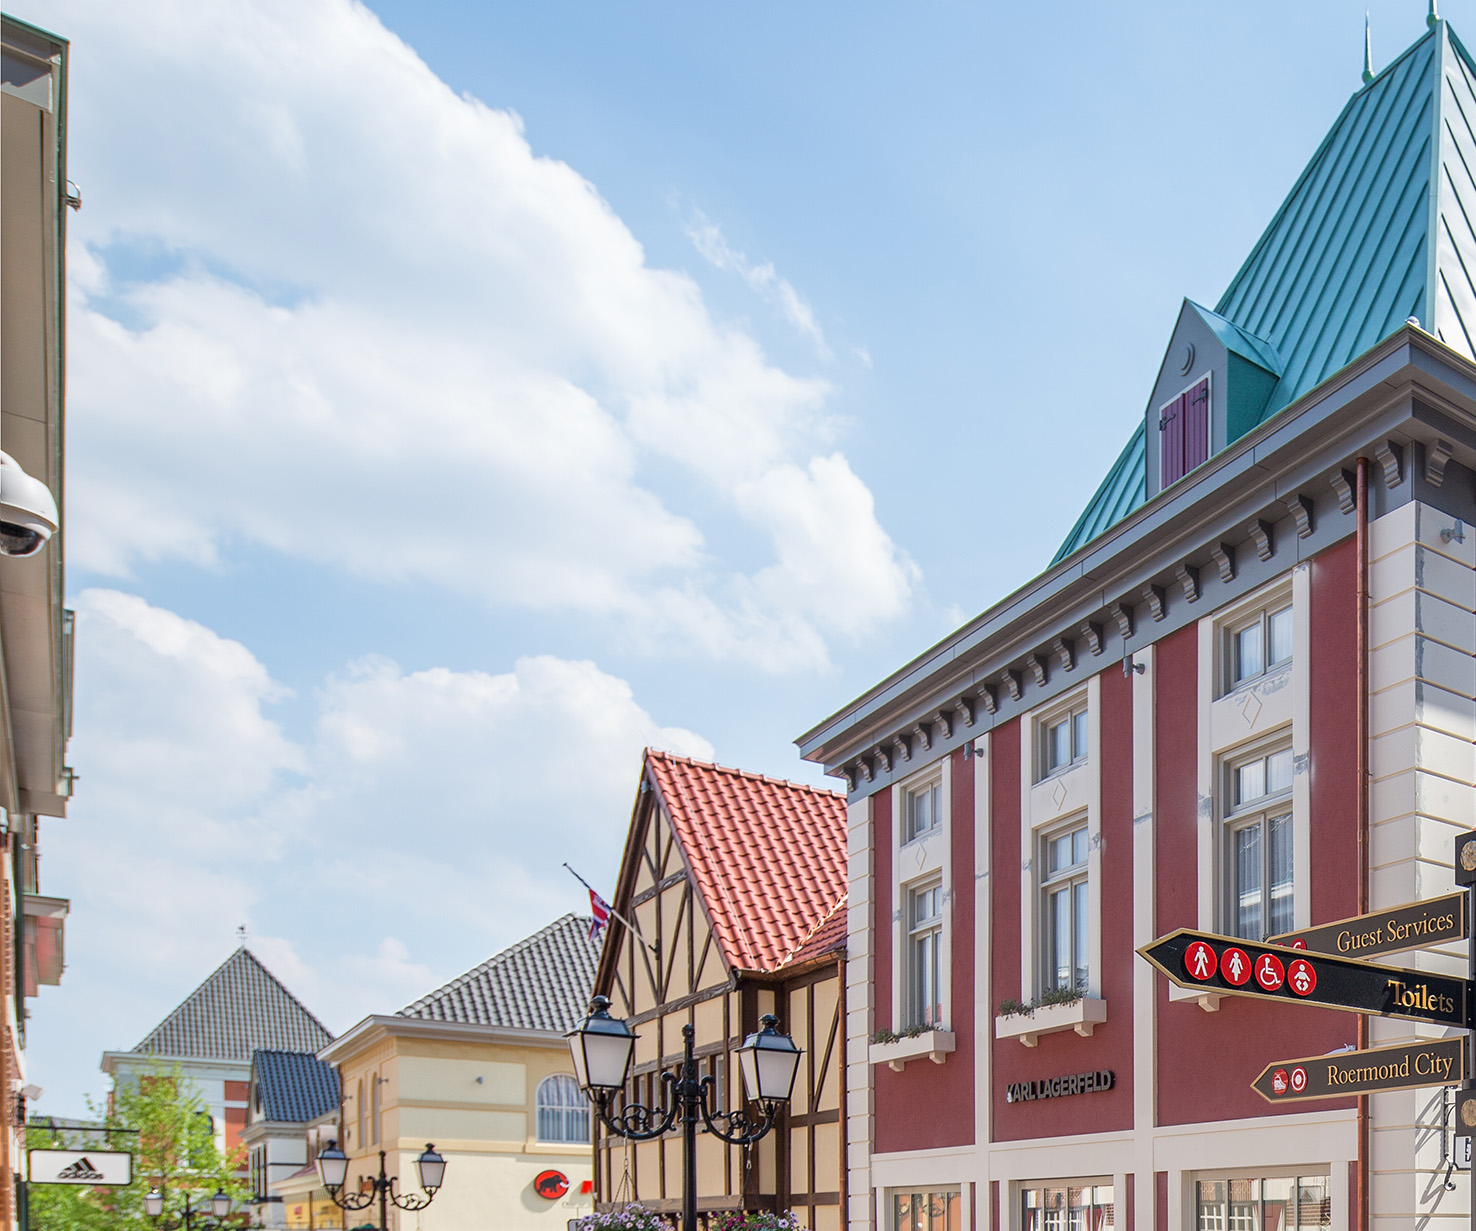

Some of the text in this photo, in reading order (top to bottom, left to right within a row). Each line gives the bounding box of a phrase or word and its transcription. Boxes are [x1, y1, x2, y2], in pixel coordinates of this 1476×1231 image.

[1337, 913, 1454, 952] Guest Services
[1387, 980, 1454, 1013] Toilets
[1327, 1052, 1453, 1086] Roermond City
[1005, 1070, 1113, 1103] KARL LAGERFELD
[58, 1170, 104, 1180] adidas
